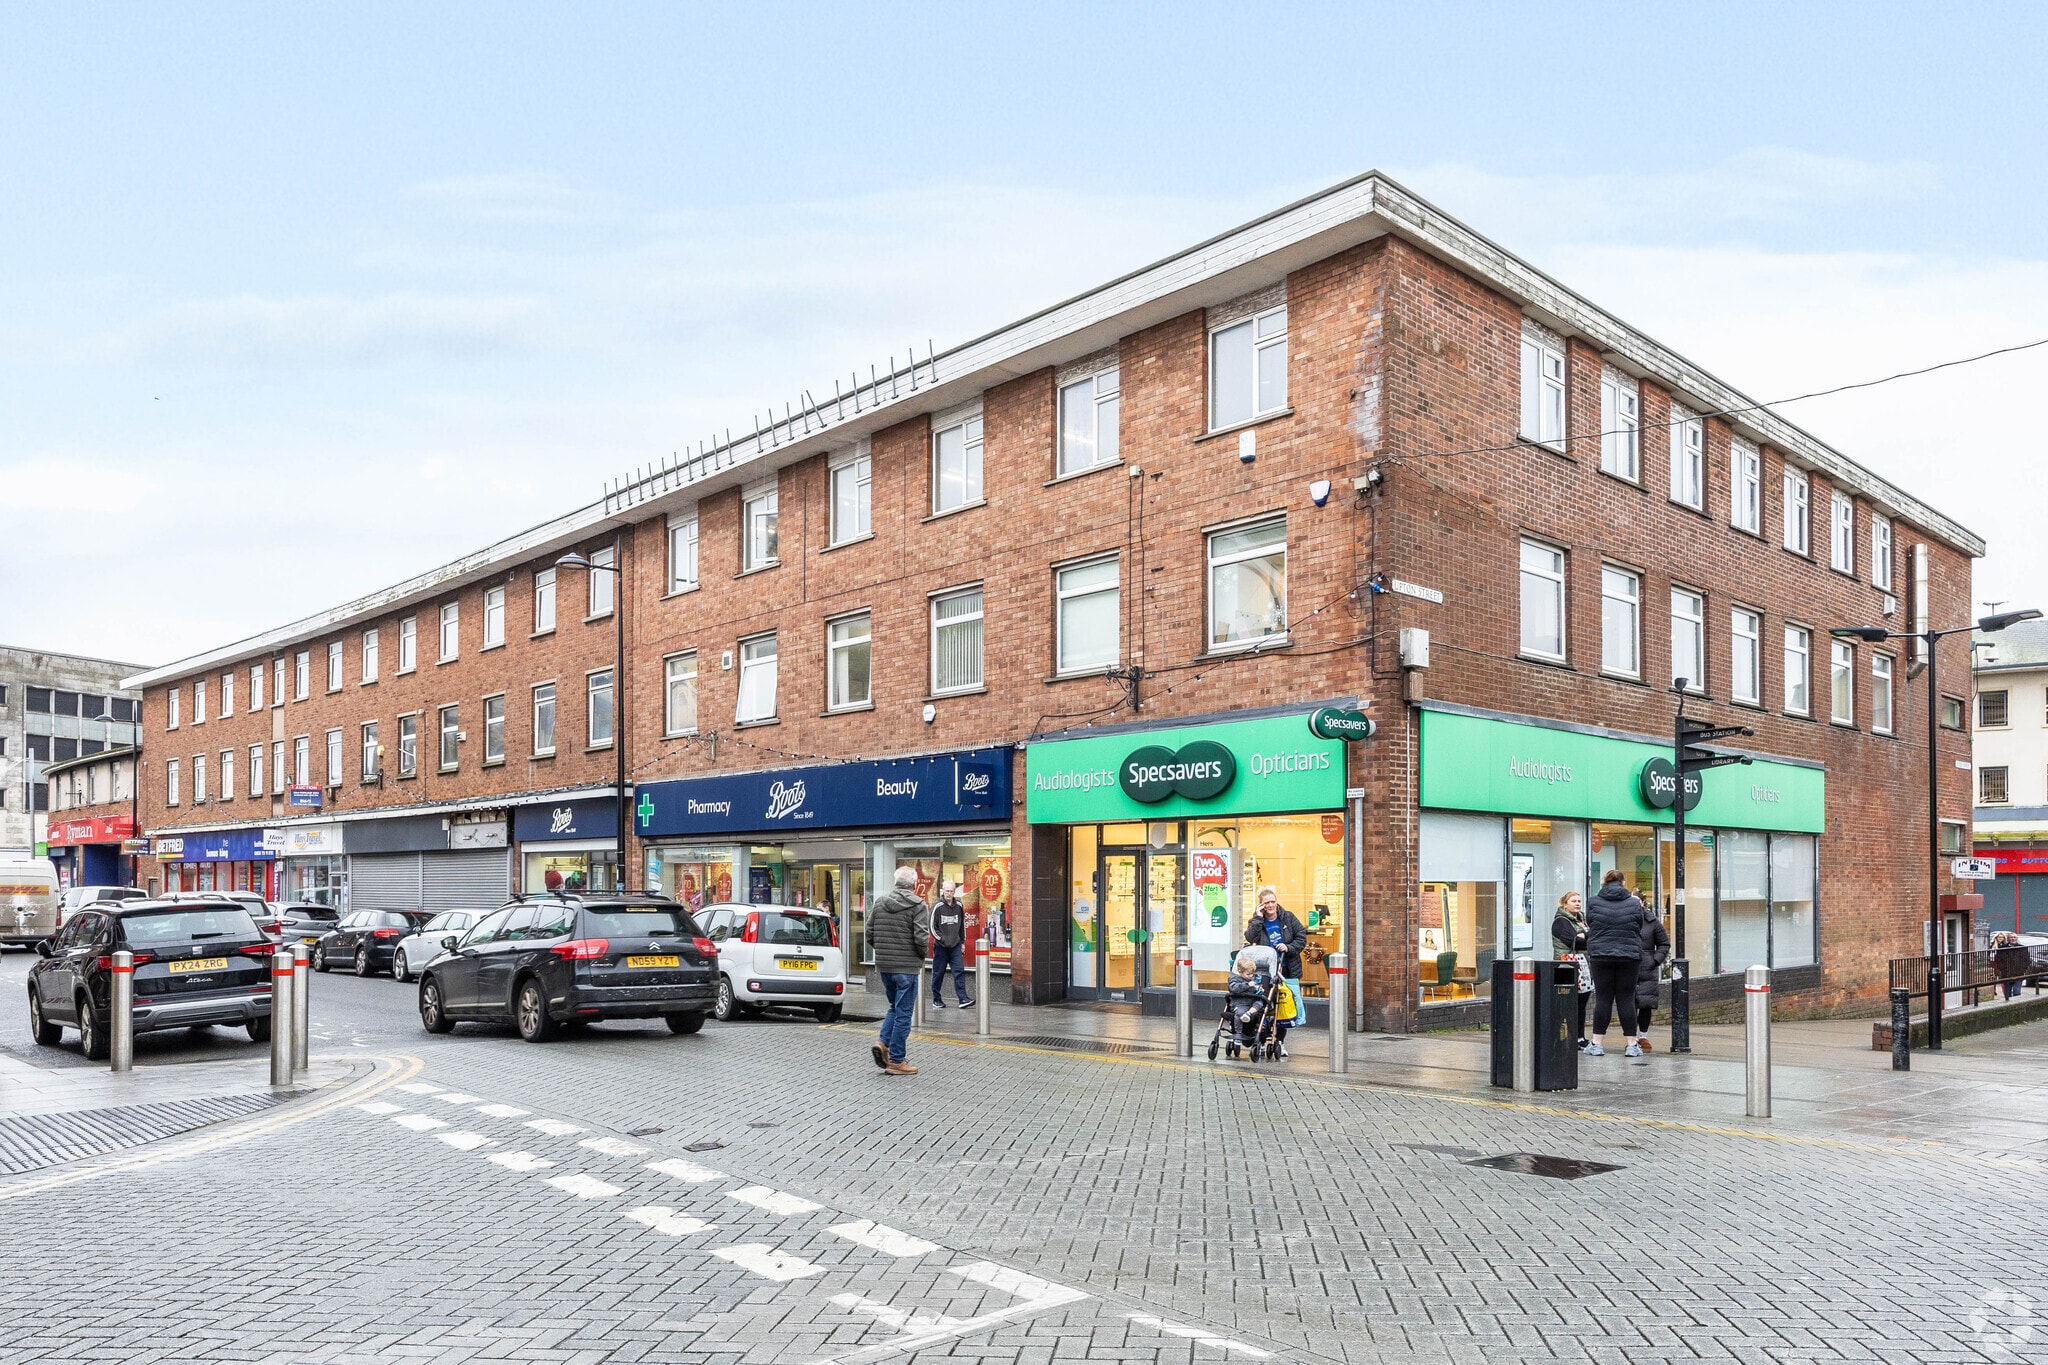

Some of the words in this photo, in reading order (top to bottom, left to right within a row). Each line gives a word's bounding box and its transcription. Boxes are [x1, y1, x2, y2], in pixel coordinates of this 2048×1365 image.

[1418, 587, 1440, 601] STREET
[1324, 715, 1367, 732] Specsavers
[1128, 759, 1222, 787] Specsavers
[1250, 752, 1330, 779] Opticians
[1509, 755, 1572, 785] Audiologists
[877, 778, 918, 800] Beauty
[963, 773, 989, 791] Boots
[1034, 768, 1115, 792] Audiologists
[1650, 771, 1698, 794] Specsers
[766, 780, 806, 819] Boots
[1750, 784, 1780, 803] Opticians
[688, 799, 730, 816] Pharmacy
[550, 808, 572, 833] Boots
[67, 824, 92, 842] Ryman
[158, 838, 184, 852] BETFRED
[206, 849, 218, 857] bonus
[220, 848, 228, 858] king
[1194, 856, 1216, 867] Two
[1958, 860, 1990, 869] INTRIM
[174, 961, 200, 971] PX24
[204, 959, 223, 968] ZRG
[632, 957, 656, 966] ND59
[659, 956, 674, 965] YZT
